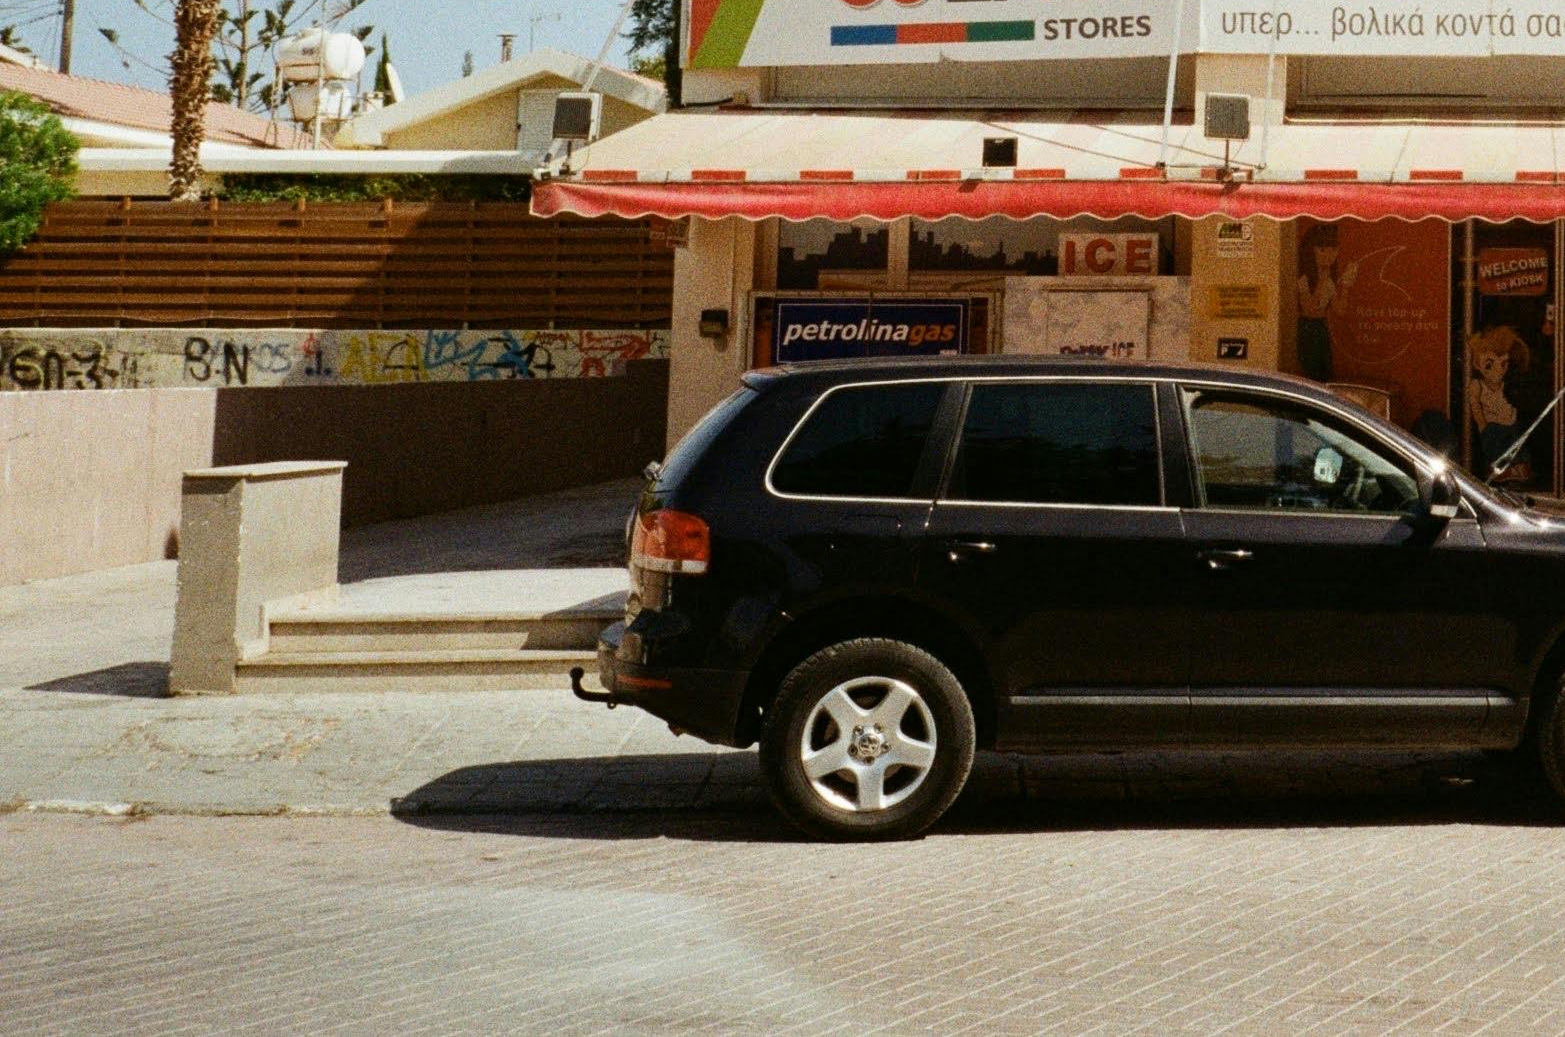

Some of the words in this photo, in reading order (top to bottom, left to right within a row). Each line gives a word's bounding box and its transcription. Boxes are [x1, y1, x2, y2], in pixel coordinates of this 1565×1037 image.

[1043, 15, 1152, 41] STORES
[1331, 6, 1424, 42] βολικά
[1436, 7, 1515, 37] κοντά
[1065, 239, 1153, 274] ICE
[1480, 257, 1548, 278] WELCOME
[1509, 274, 1544, 288] KIOSK
